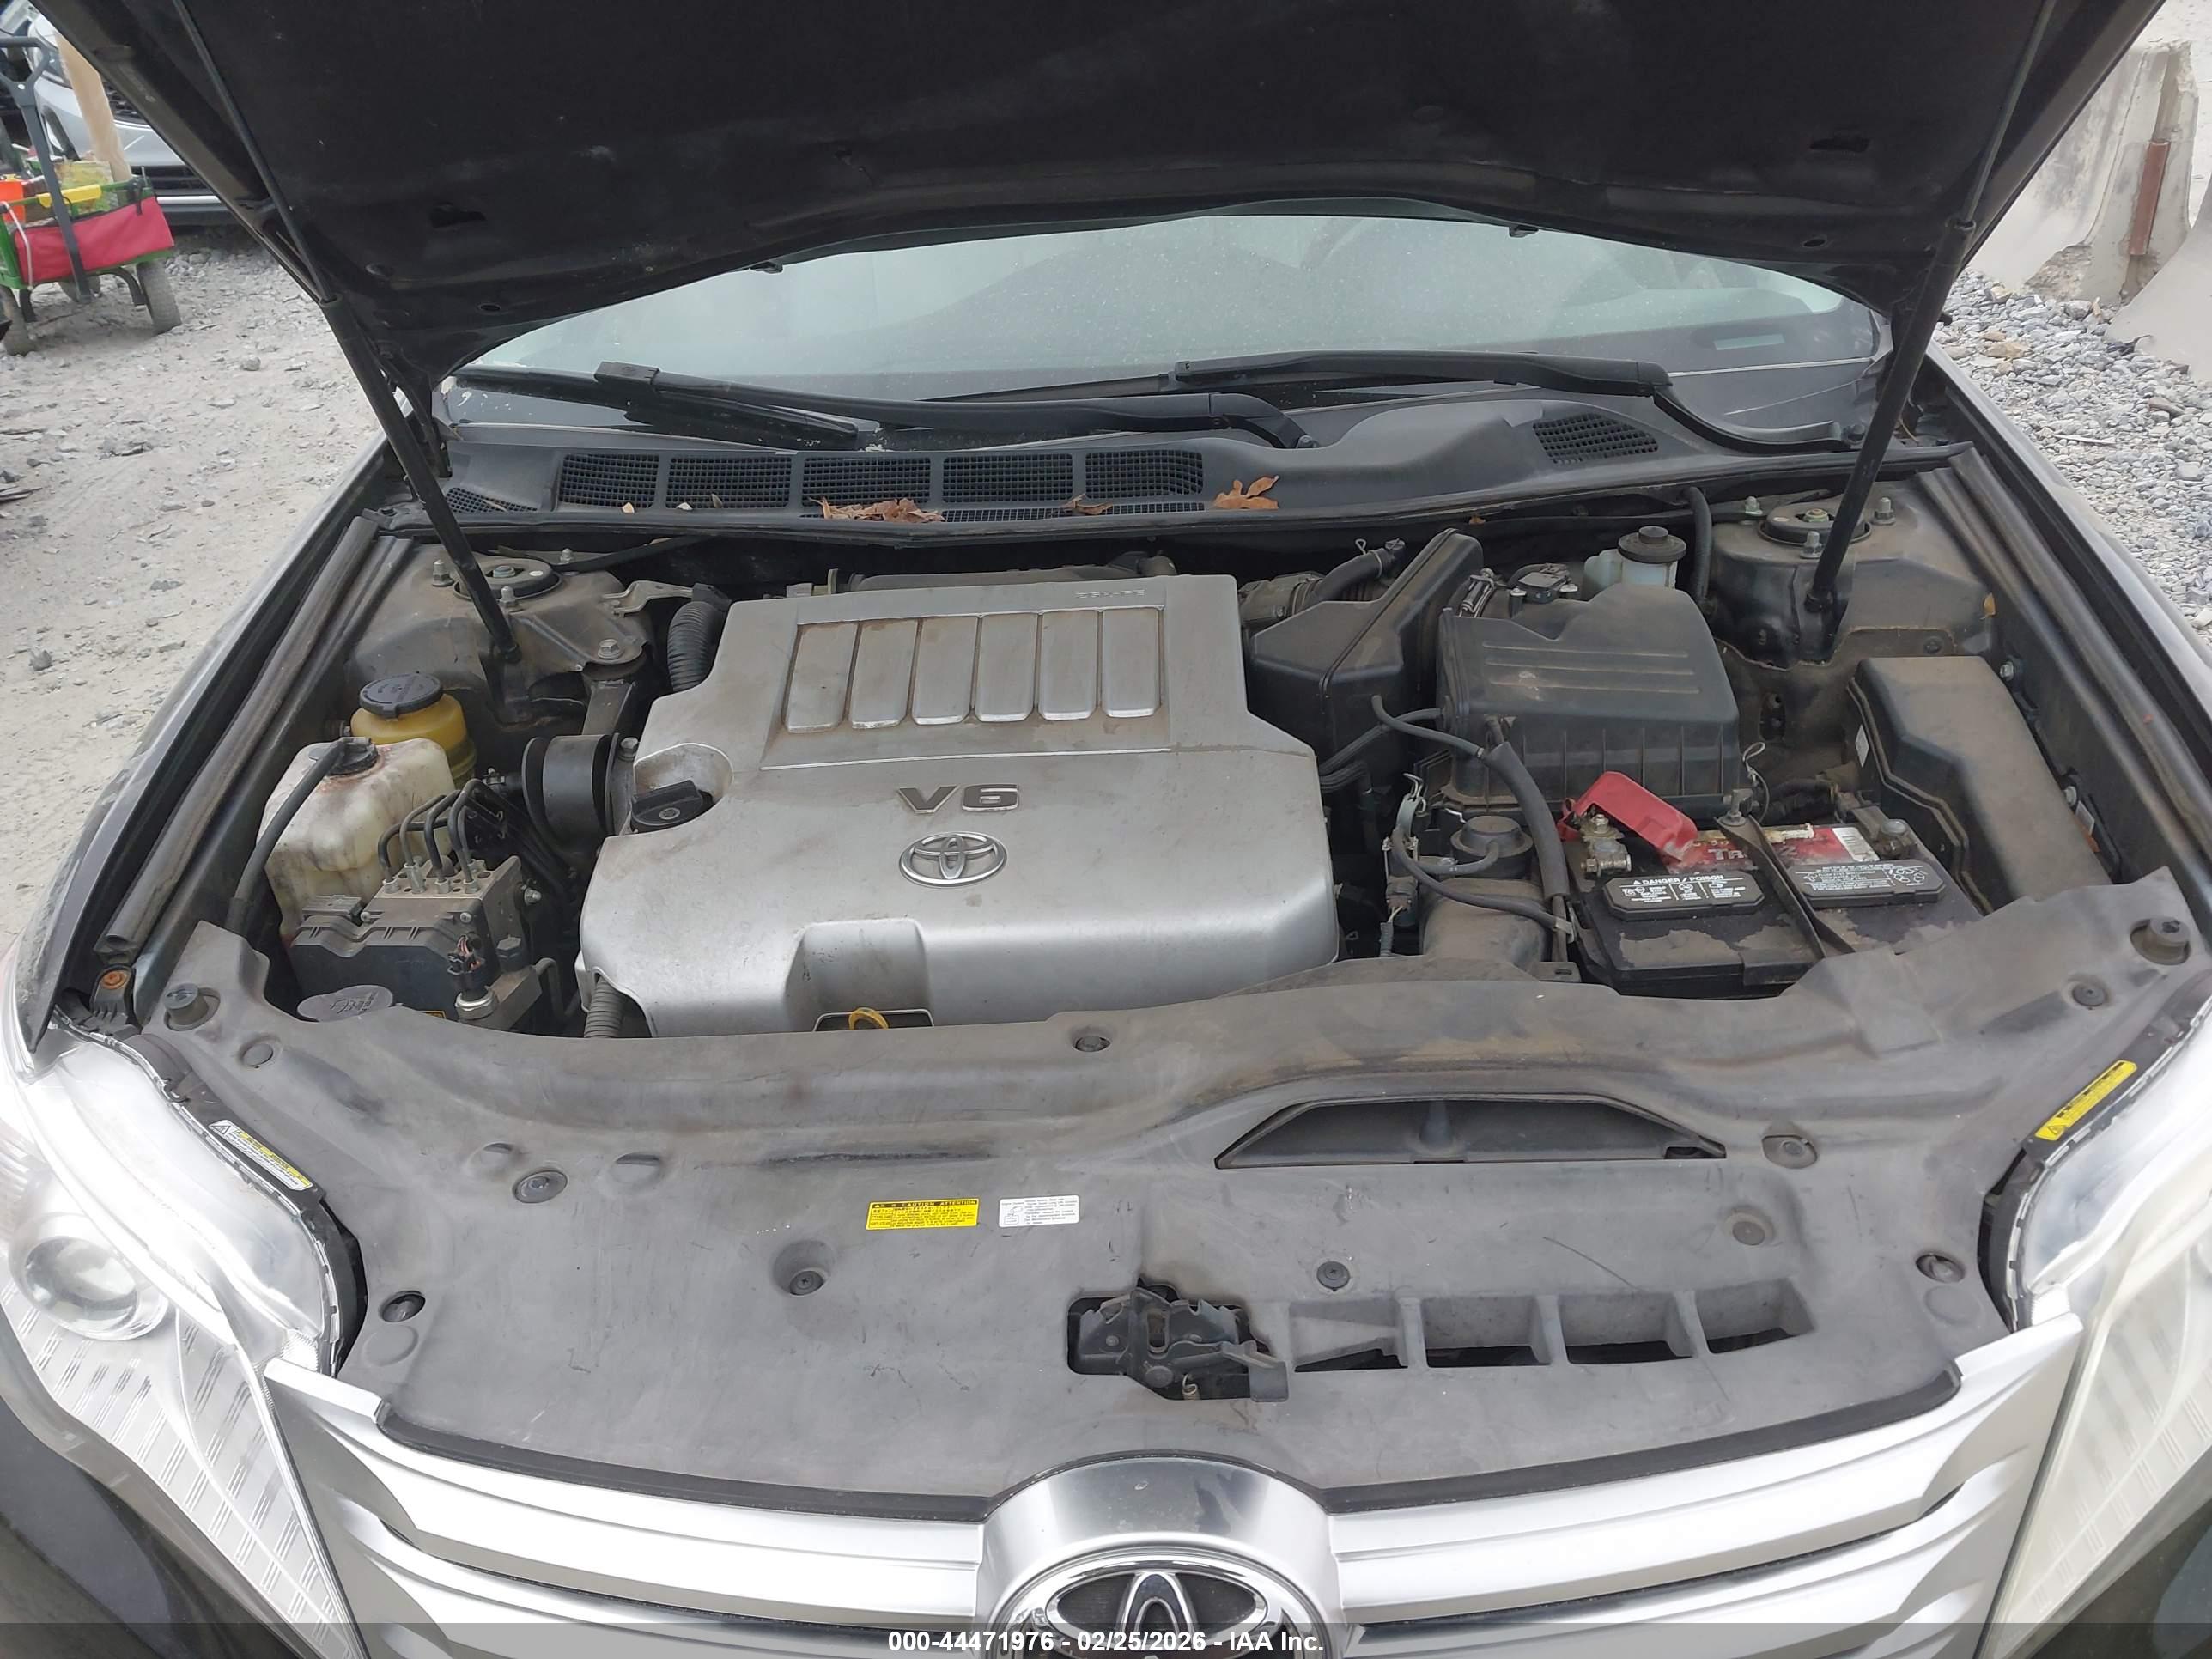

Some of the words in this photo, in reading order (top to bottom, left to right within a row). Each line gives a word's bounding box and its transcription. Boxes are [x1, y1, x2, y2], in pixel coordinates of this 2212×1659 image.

[897, 783, 1019, 813] V6
[1641, 876, 1680, 885] DANGER
[1690, 874, 1725, 883] POISON
